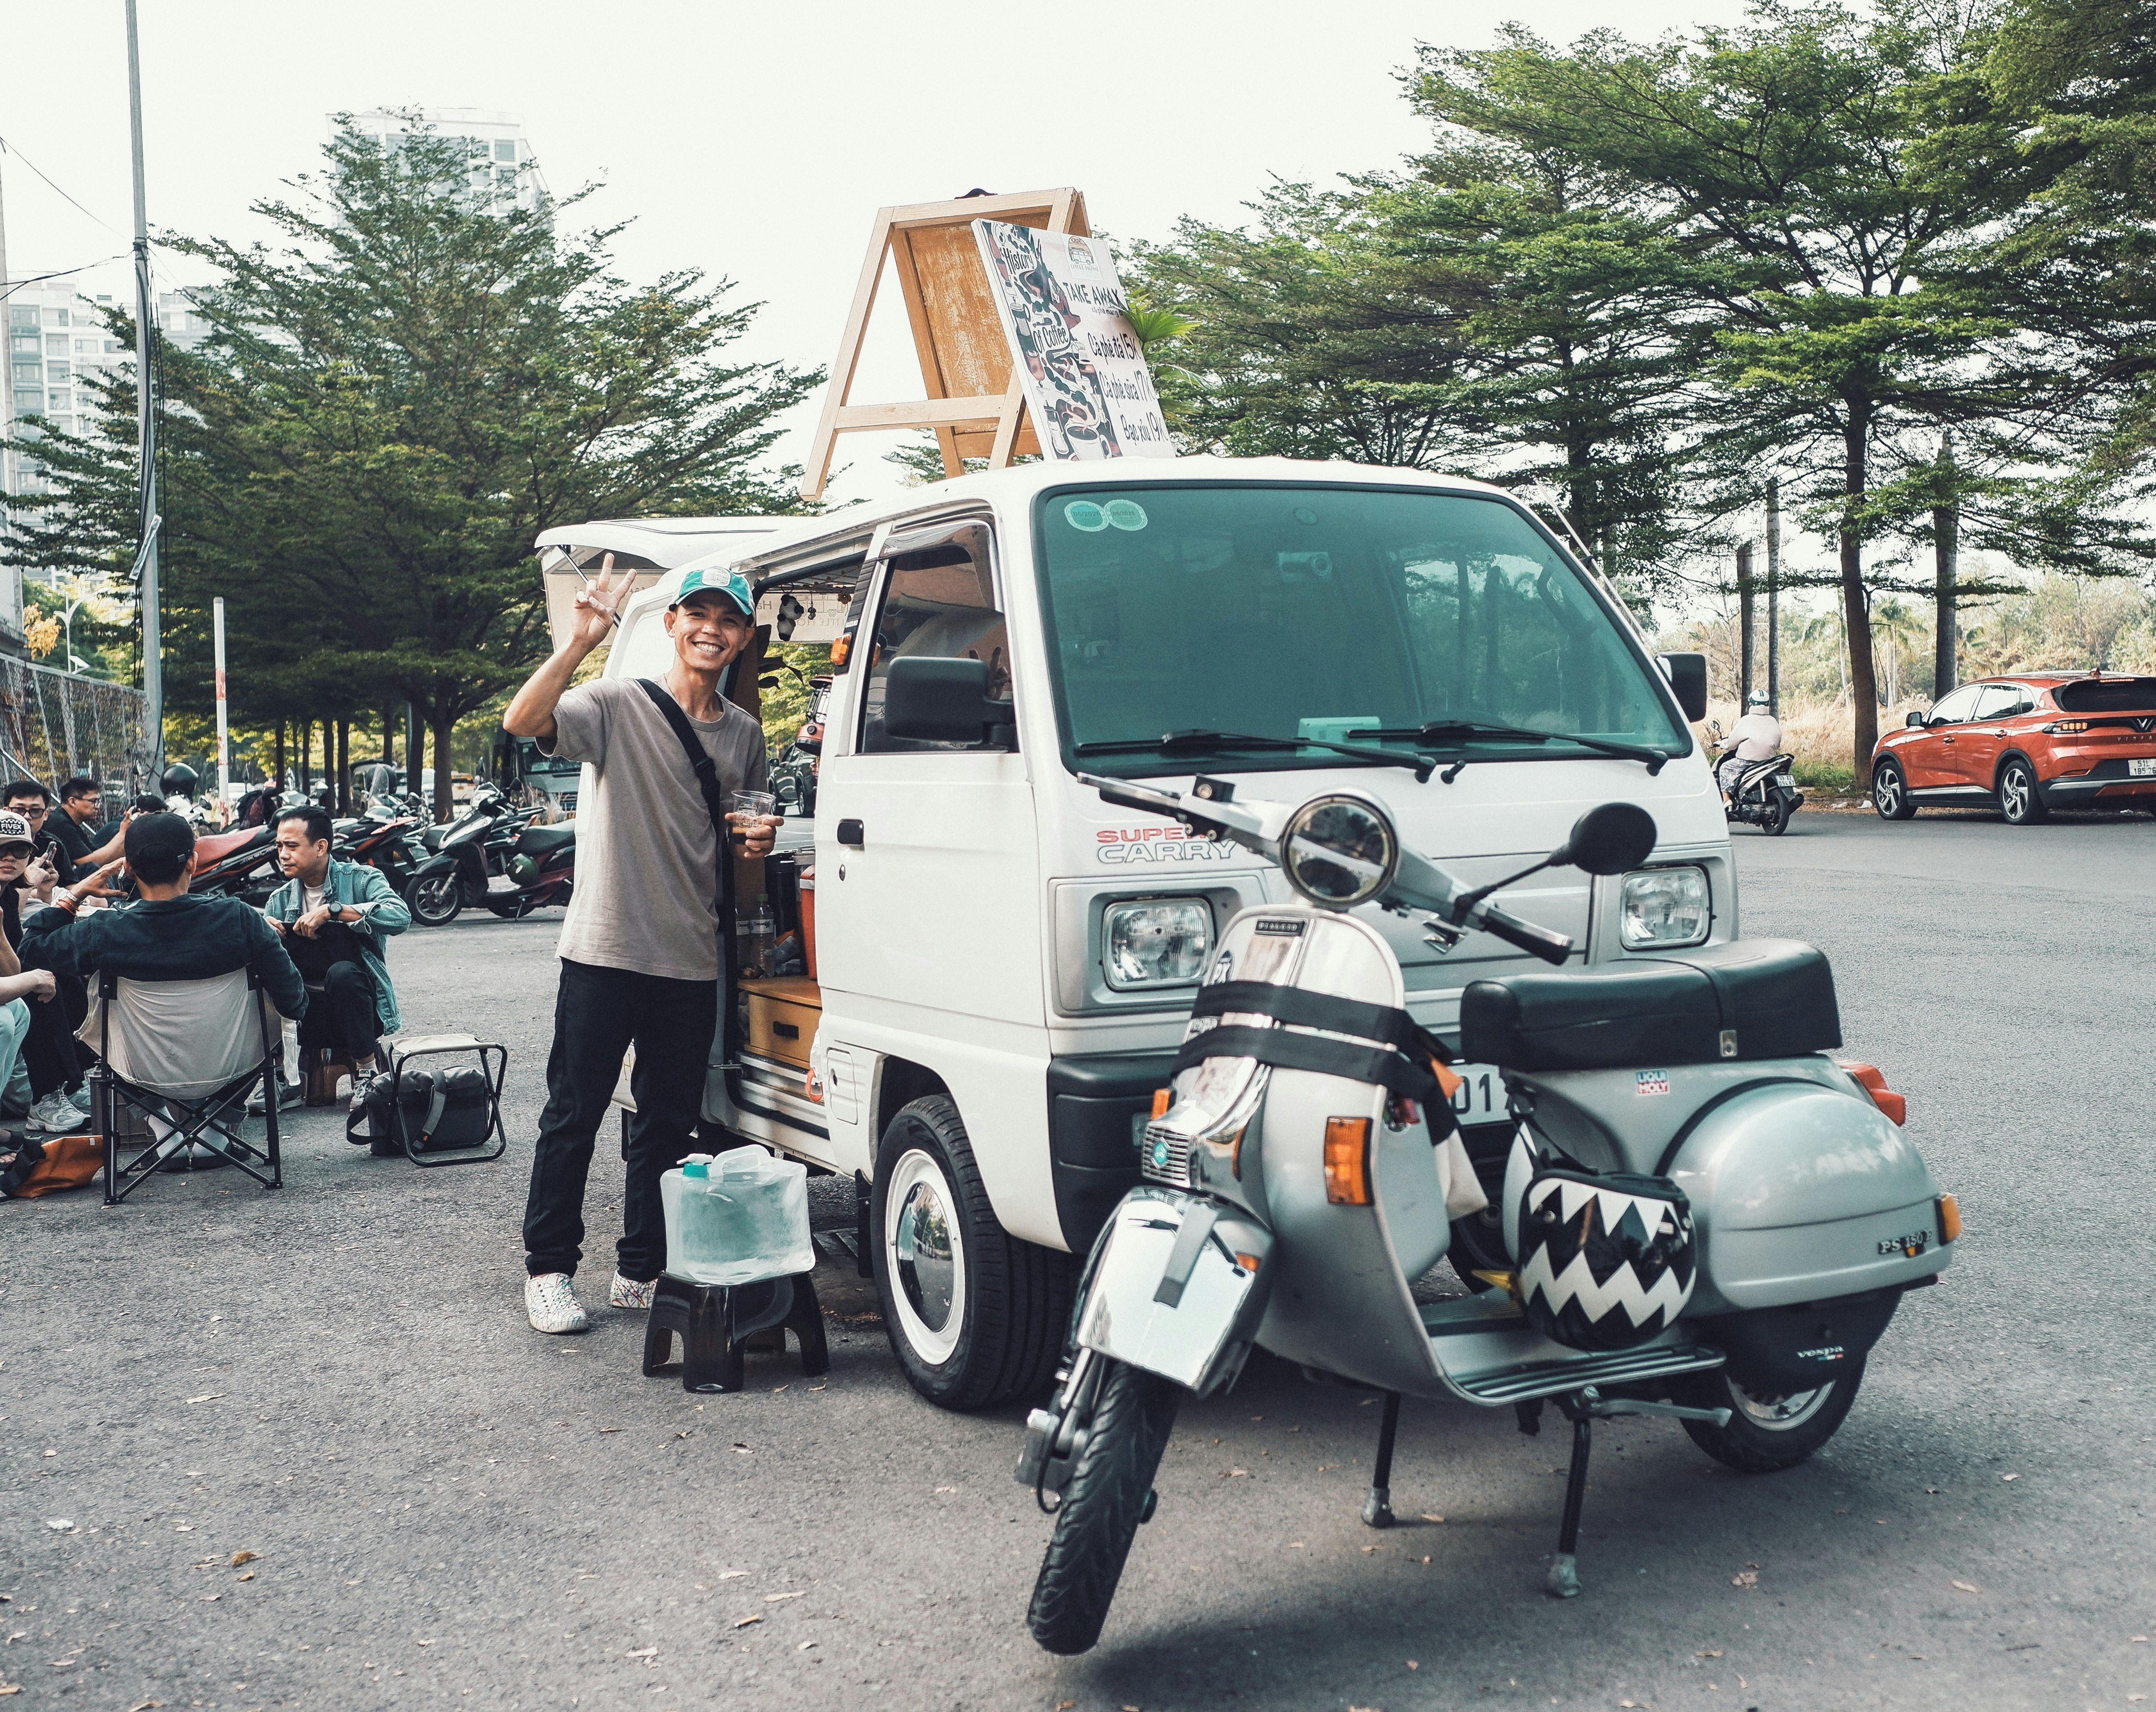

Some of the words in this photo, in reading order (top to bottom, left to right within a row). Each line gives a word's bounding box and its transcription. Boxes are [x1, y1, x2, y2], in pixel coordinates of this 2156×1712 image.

[1002, 247, 1035, 274] History
[1062, 282, 1092, 304] TAKE
[1092, 286, 1122, 307] AWAY
[1106, 309, 1119, 318] mang
[1033, 329, 1045, 354] Of
[1042, 325, 1069, 348] Coffee
[1088, 332, 1103, 356] Cà
[1101, 334, 1115, 365] phê
[1113, 335, 1126, 360] đá
[1099, 371, 1114, 400] Cà
[1112, 373, 1125, 408] phê
[1124, 378, 1140, 401] sữa
[1120, 414, 1140, 446] Bạc
[1097, 827, 1207, 843] SUPE
[1096, 839, 1237, 864] CARRY
[1258, 922, 1298, 931] PIAGGIO
[1638, 1071, 1666, 1082] LIQUI
[1639, 1082, 1668, 1094] MOLY
[1880, 1238, 1902, 1253] PS
[1797, 1346, 1844, 1358] vespa
